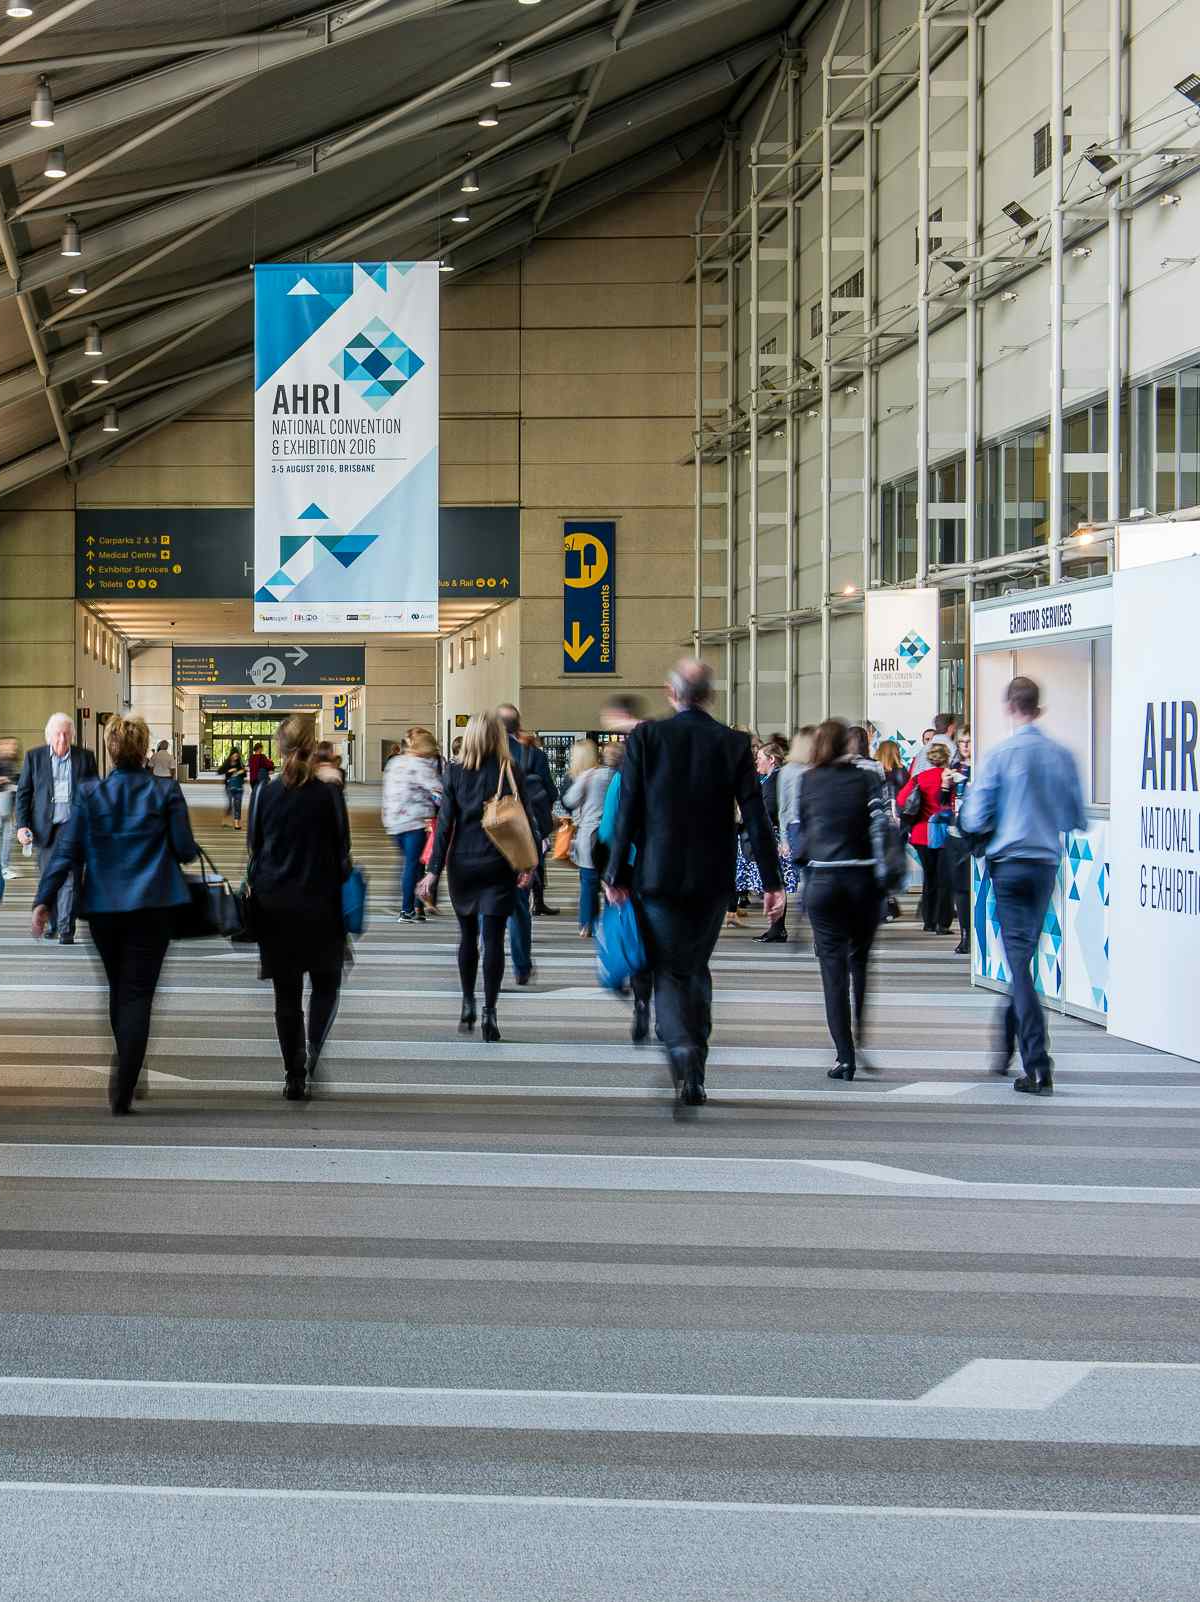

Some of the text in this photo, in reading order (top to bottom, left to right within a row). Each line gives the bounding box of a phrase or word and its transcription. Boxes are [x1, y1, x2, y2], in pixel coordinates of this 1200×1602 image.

[272, 384, 340, 414] AHRI
[272, 418, 401, 435] NATIONAL CONVENTION
[271, 438, 376, 456] & EXHIBITION 2016
[272, 464, 376, 473] 3-5 AUGUST 2016, BRISBANE
[99, 536, 134, 546] Carparks
[136, 536, 142, 545] 2
[143, 536, 150, 545] &
[152, 536, 158, 545] 3
[99, 551, 157, 559] Medical Centre
[99, 565, 169, 573] Exhibitor Services
[99, 580, 123, 589] Toilets
[459, 578, 474, 587] Rail
[599, 584, 610, 663] Refreshments
[1009, 603, 1072, 634] EXHIBITOR SERVICES
[873, 658, 899, 672] AHRI
[245, 662, 277, 684] Hall 2
[256, 694, 267, 708] 3
[1140, 806, 1195, 854] NATIONAL
[1140, 864, 1200, 917] & EXHIBITI
